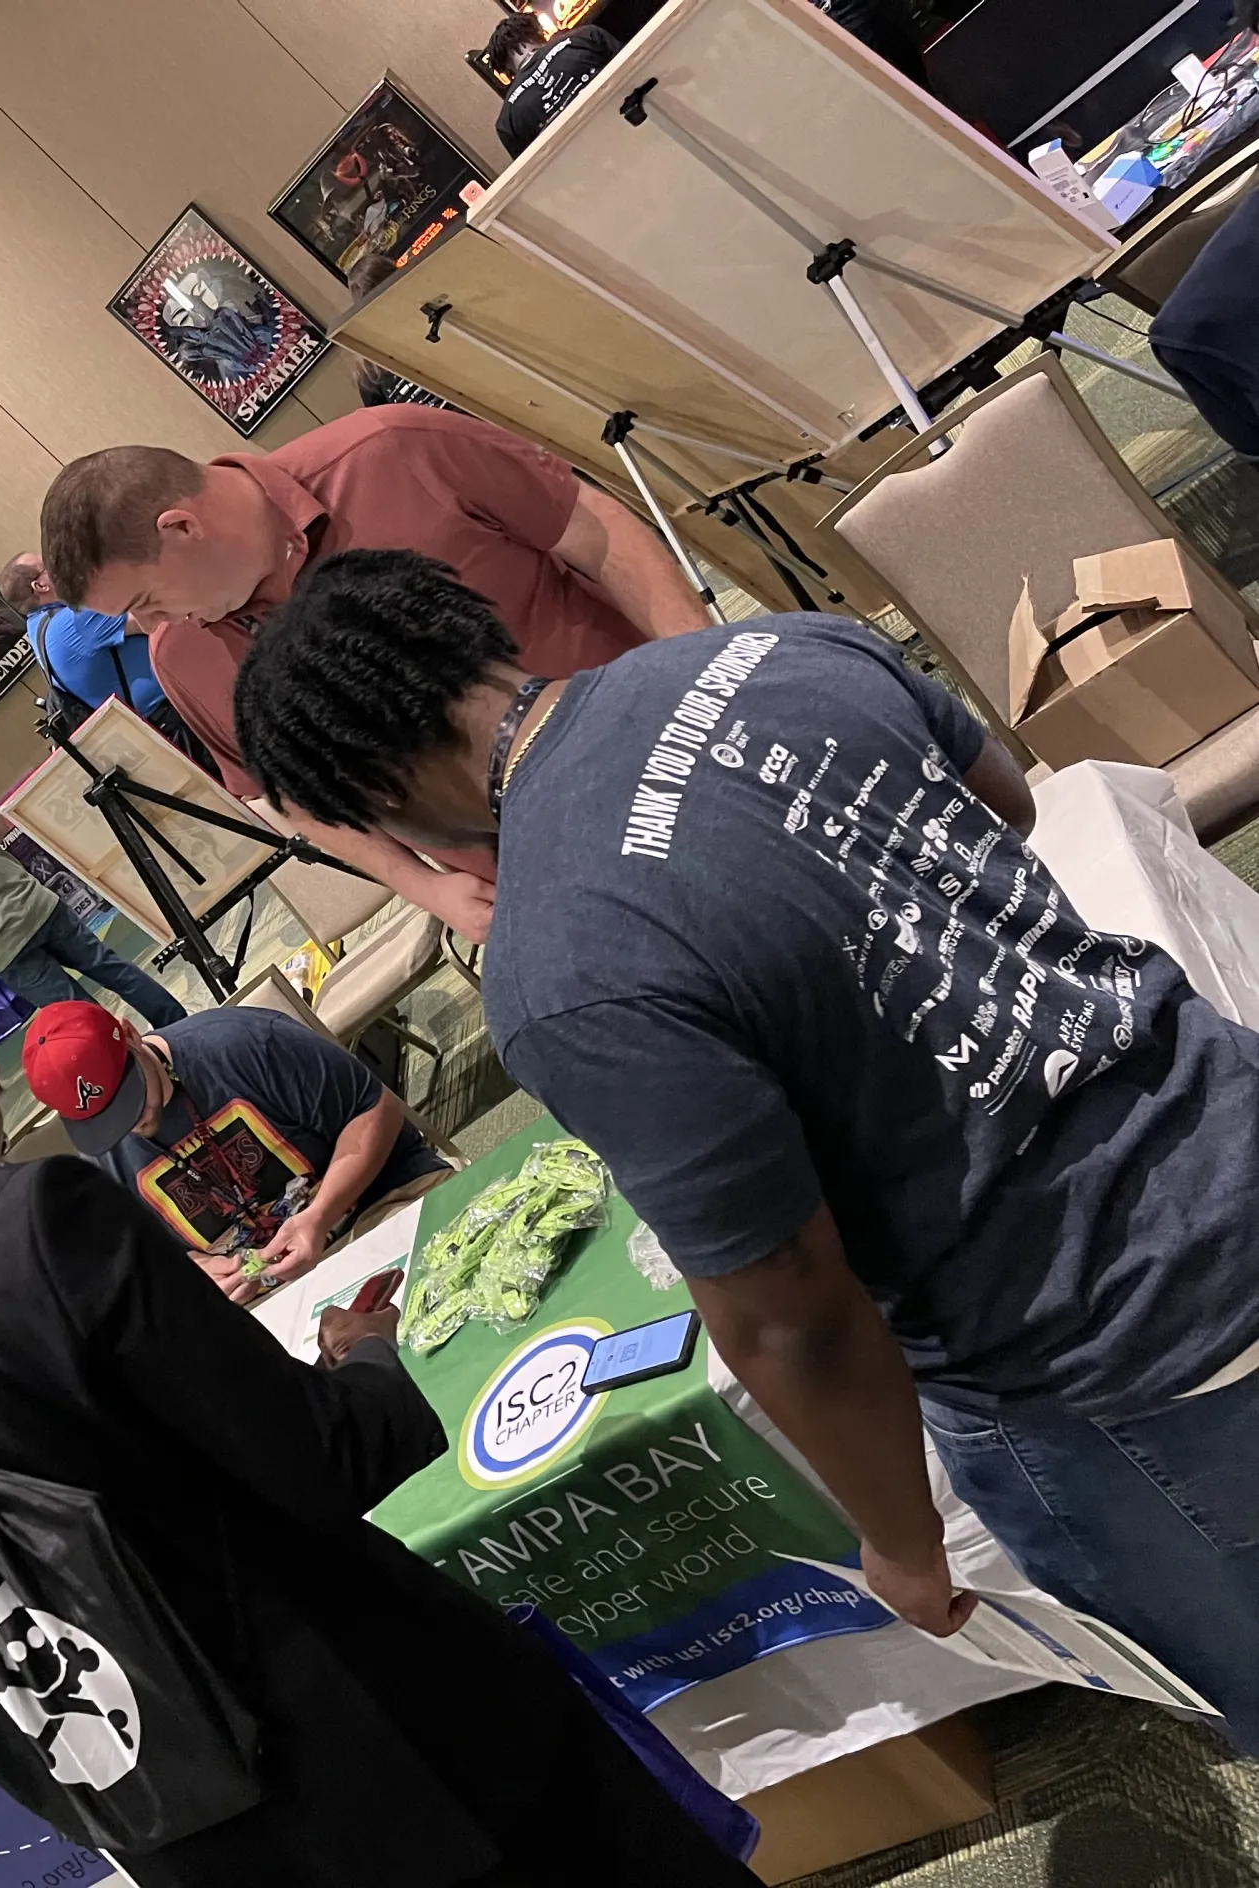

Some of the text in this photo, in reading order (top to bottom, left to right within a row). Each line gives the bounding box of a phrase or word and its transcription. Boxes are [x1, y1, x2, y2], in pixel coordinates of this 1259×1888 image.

[402, 184, 438, 224] RINGS
[236, 334, 319, 423] SPEAKER
[621, 632, 780, 859] THANK YOU TO OUR SPONSORS
[758, 743, 789, 784] orca
[783, 789, 813, 834] amazo
[937, 797, 965, 828] NTG
[985, 867, 1028, 938] EXTRAHOP
[937, 916, 957, 955] SECUR
[945, 922, 967, 961] JOURN
[1058, 1008, 1077, 1045] APEX
[1070, 999, 1097, 1053] SYSTEMS
[495, 1391, 576, 1446] CHAPTER
[496, 1360, 578, 1429] ISC2
[434, 1422, 722, 1587] AMPA BAY
[497, 1475, 777, 1624] safe and secure
[555, 1523, 760, 1638] cyber world
[622, 1652, 672, 1681] with
[677, 1640, 710, 1662] us!
